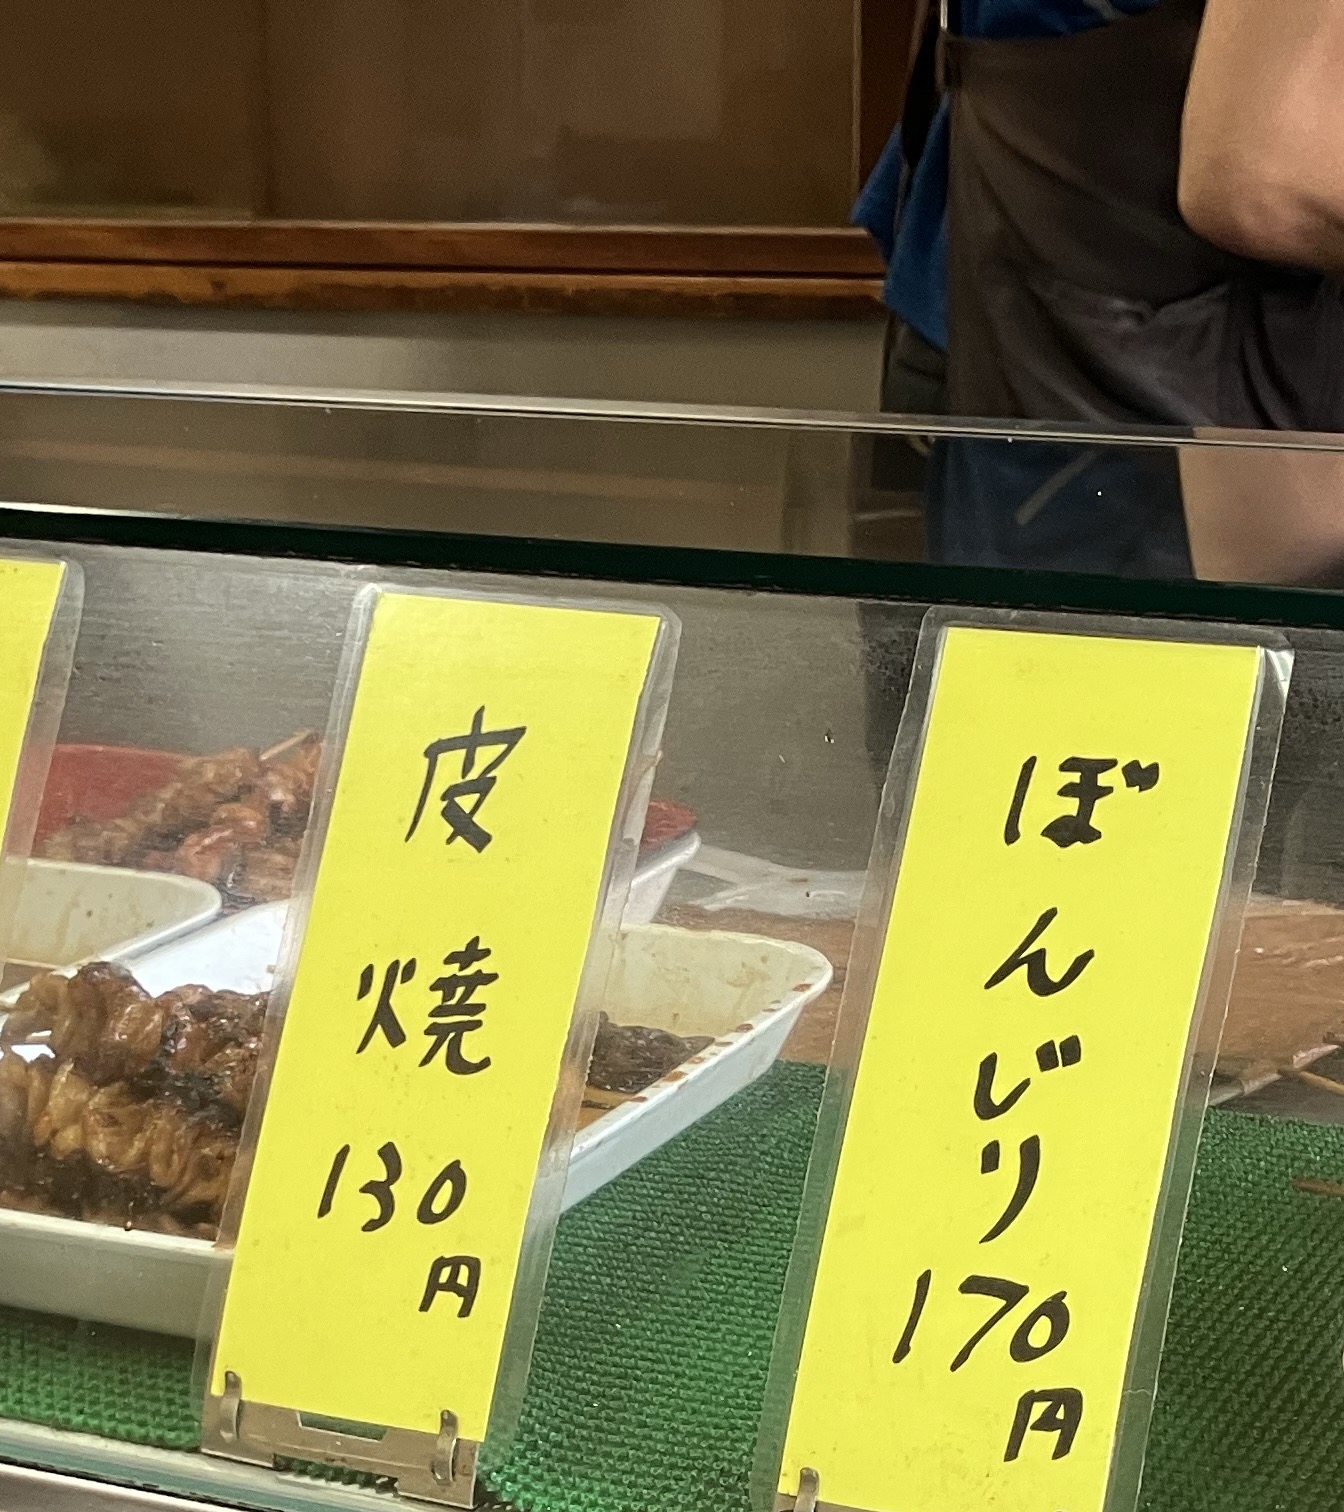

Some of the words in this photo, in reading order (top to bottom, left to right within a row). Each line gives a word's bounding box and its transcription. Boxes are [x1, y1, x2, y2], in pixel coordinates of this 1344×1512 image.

[355, 705, 526, 1075] 皮焼
[979, 754, 1161, 1244] ぼんじり
[318, 1142, 481, 1318] 130円
[892, 1269, 1083, 1462] 170円
